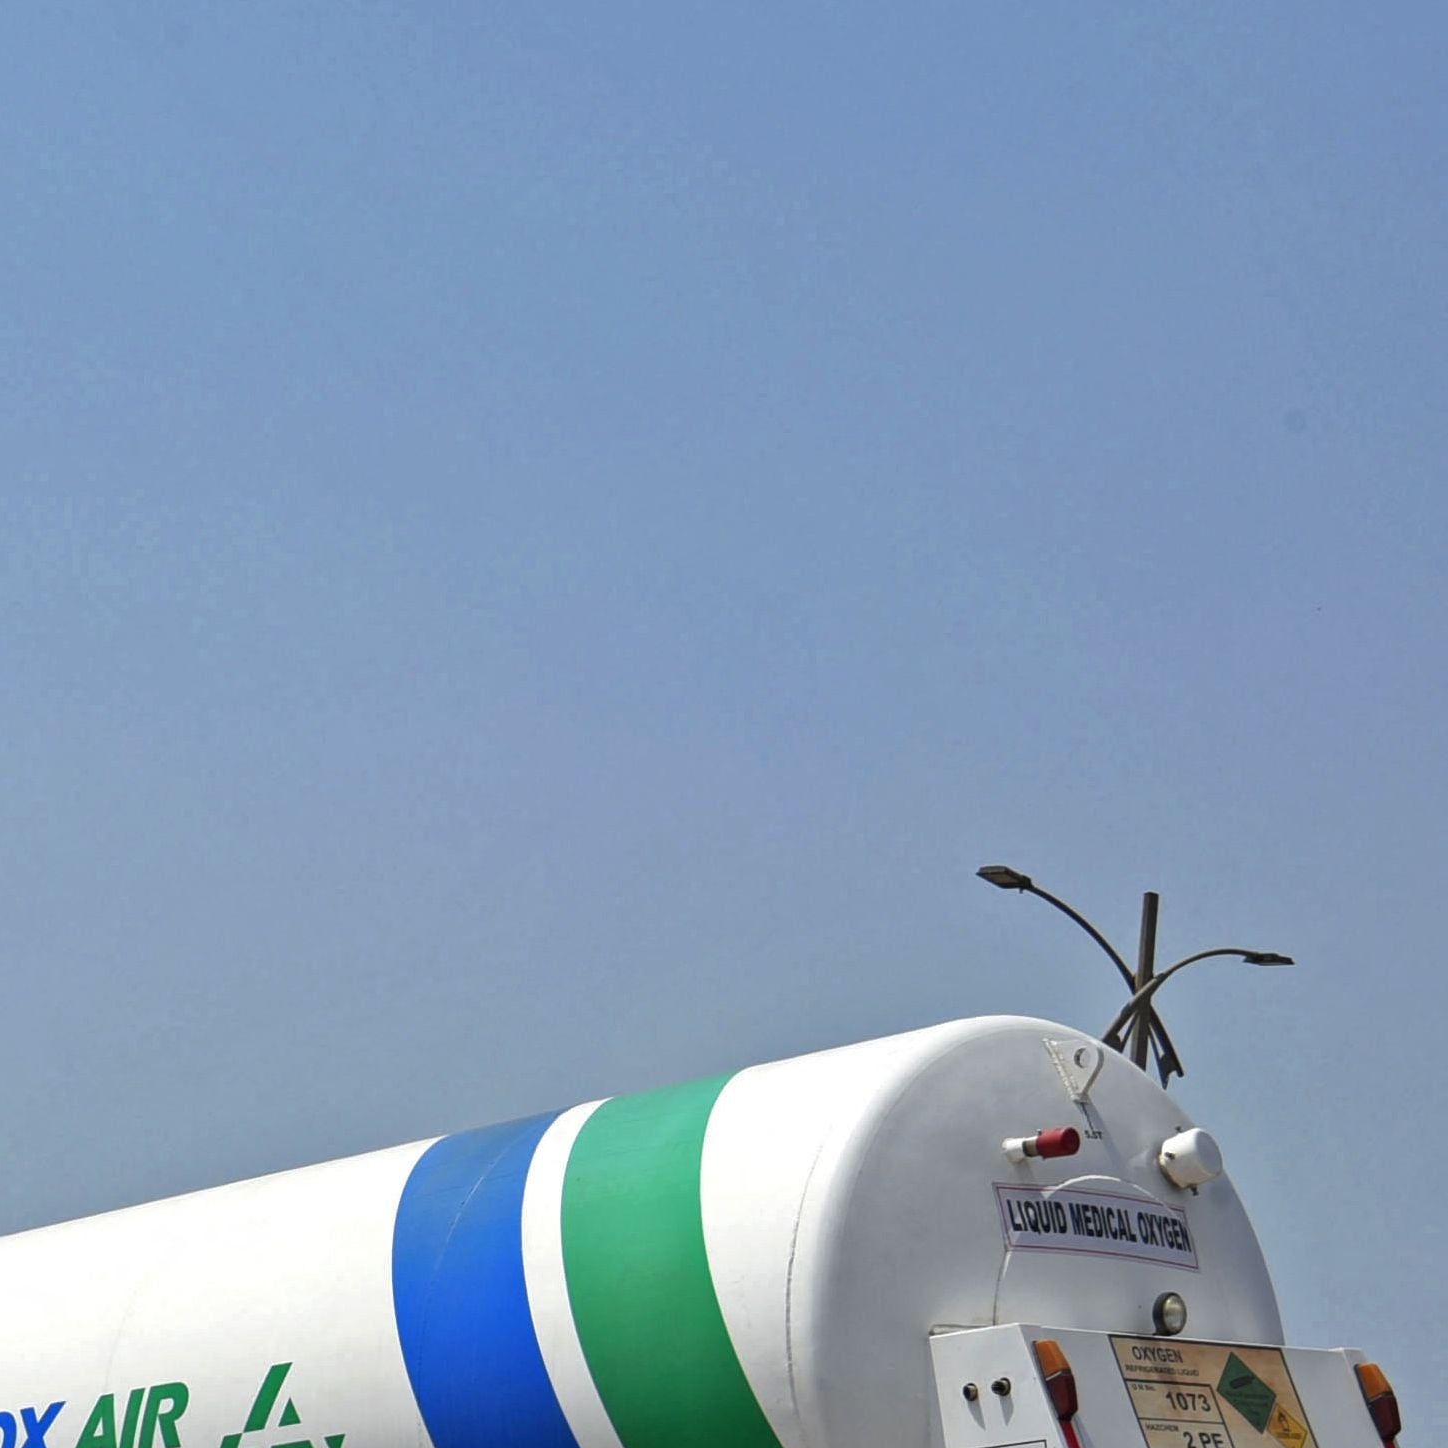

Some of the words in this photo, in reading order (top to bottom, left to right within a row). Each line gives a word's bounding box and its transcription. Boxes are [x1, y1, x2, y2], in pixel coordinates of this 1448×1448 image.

[1006, 1199, 1067, 1235] LIQUID
[1069, 1203, 1137, 1243] MEDICAL
[1137, 1211, 1192, 1252] OXYGEN
[1132, 1346, 1183, 1363] OXYGEN
[1166, 1391, 1211, 1412] 1073
